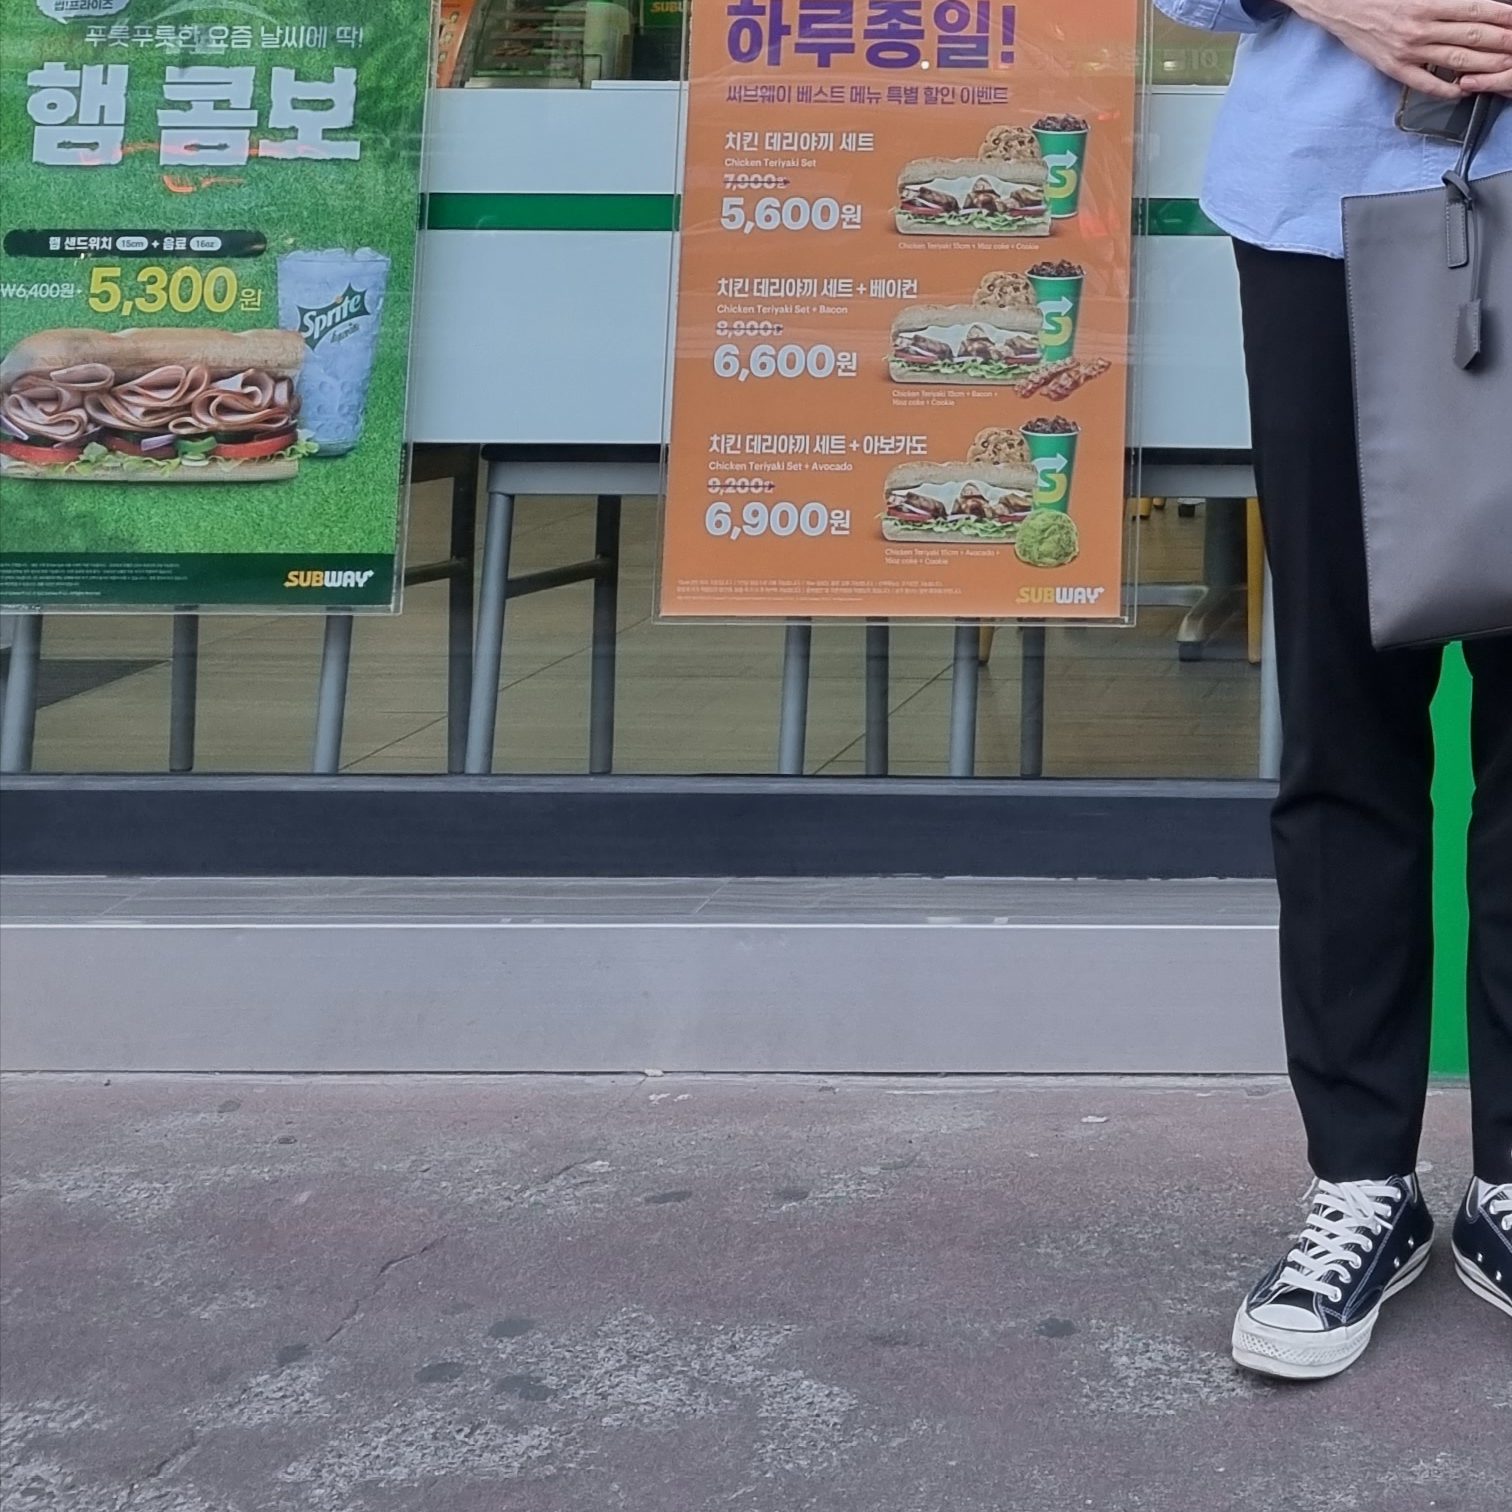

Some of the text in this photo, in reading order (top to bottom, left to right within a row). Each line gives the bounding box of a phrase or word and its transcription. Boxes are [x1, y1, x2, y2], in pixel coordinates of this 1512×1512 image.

[85, 25, 364, 50] 푸릇푸릇한 요즘 날씨에 딱!
[725, 84, 1008, 105] 써브웨이 베스트 메뉴 특별 할인 이벤트
[26, 61, 129, 167] 햄
[724, 130, 875, 153] 치킨 데리야끼 세트
[724, 157, 817, 169] Chicken Teriyaki Set
[720, 196, 862, 234] 5,600원
[64, 236, 112, 251] 샌드위치
[121, 239, 145, 248] 15cm
[163, 236, 187, 251] 음료
[88, 266, 262, 316] 5,300원
[716, 278, 749, 298] 치킨
[752, 278, 818, 298] 데리야끼
[820, 278, 853, 298] 세트
[869, 279, 918, 299] 베이컨
[301, 295, 361, 340] Sprite
[716, 304, 755, 314] Chicken
[757, 304, 793, 315] Teriyaki
[795, 304, 810, 314] Set
[819, 305, 848, 314] Bacon
[713, 343, 858, 382] 6,600원
[709, 434, 741, 454] 치킨
[745, 434, 810, 454] 데리야끼
[813, 434, 846, 454] 세트
[863, 435, 928, 455] 아보카도
[708, 461, 746, 471] Chicken
[749, 461, 785, 472] Teriyaki
[786, 461, 802, 471] Set
[811, 461, 853, 471] Avocado
[705, 501, 851, 540] 6,900원
[284, 569, 374, 588] SUBWAY
[1016, 586, 1105, 604] SUBWAY
